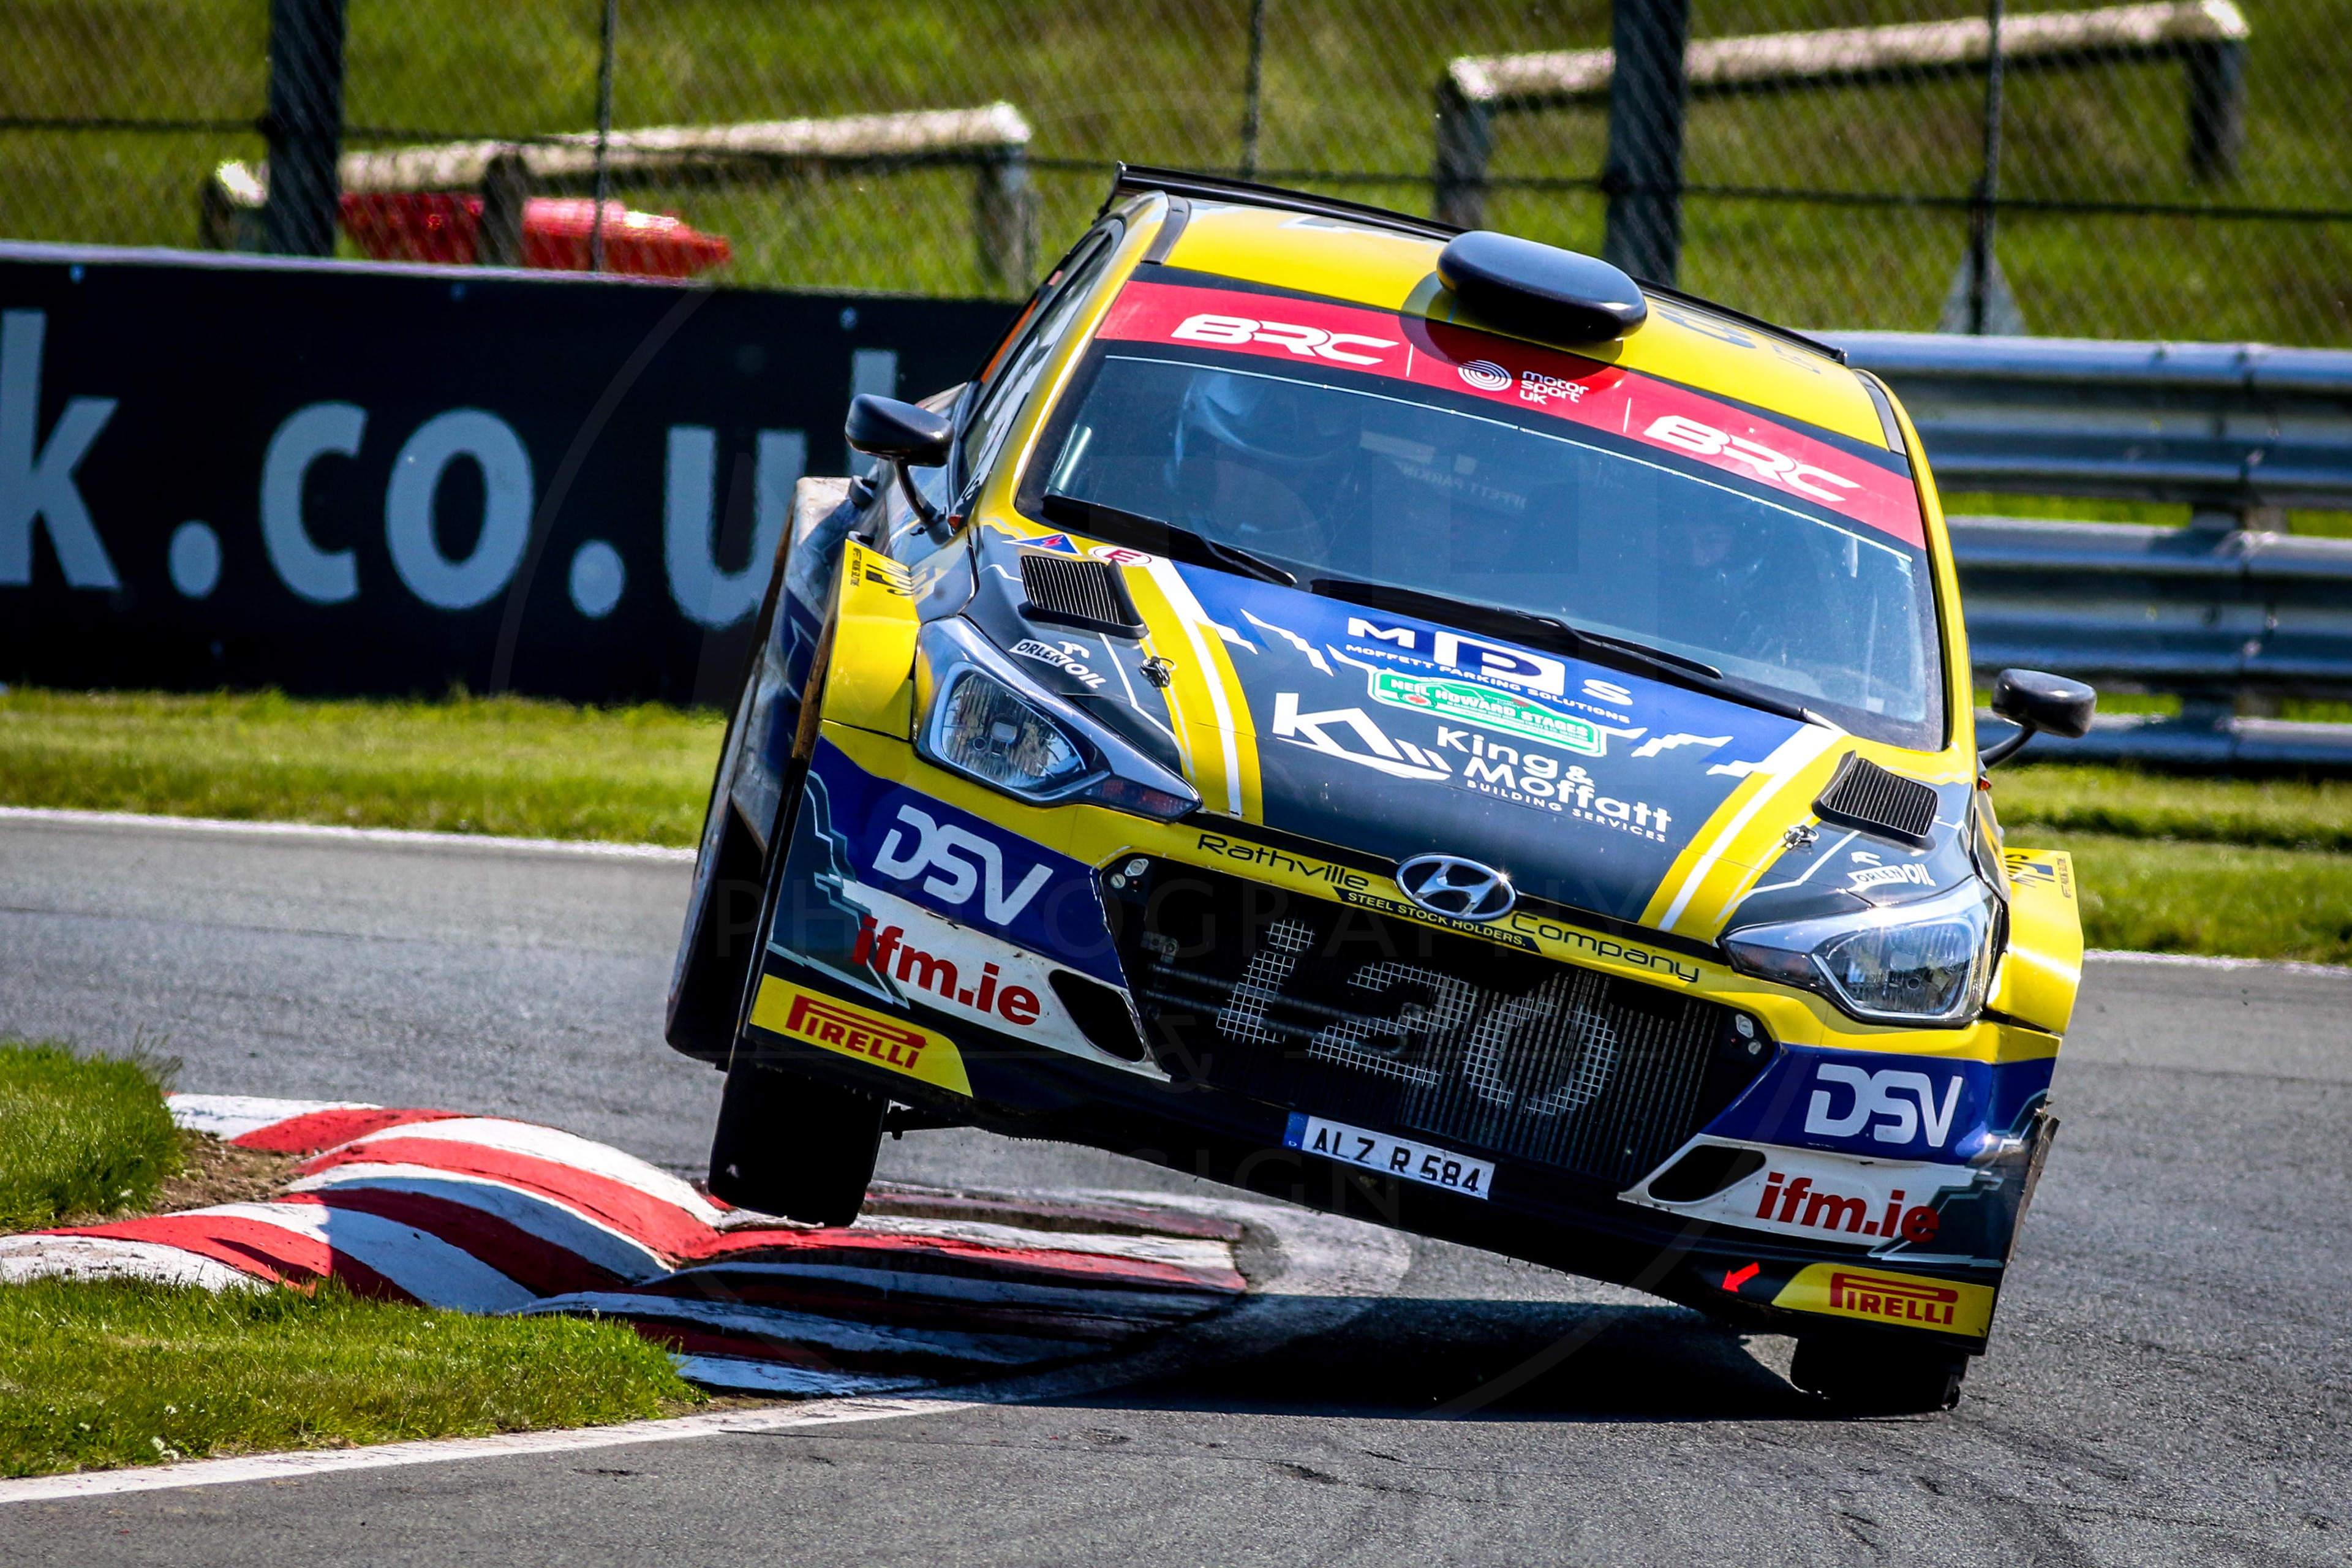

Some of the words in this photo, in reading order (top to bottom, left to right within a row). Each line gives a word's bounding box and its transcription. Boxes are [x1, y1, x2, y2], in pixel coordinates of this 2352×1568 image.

[1170, 313, 1400, 366] BRC
[1520, 380, 1580, 403] sport
[1522, 371, 1589, 395] motor
[1643, 415, 1862, 502] BRC
[1016, 642, 1067, 664] ORLEN
[1064, 663, 1107, 689] OIL
[1345, 644, 1435, 669] MOFFETT
[1439, 665, 1522, 692] PARKING
[1527, 687, 1630, 725] SOLUTIONS
[1390, 677, 1431, 698] NEIL
[1434, 688, 1517, 718] HOWARD
[1520, 709, 1589, 736] STAGES
[1463, 757, 1672, 834] Moffatt
[1466, 780, 1562, 812] BUILDING
[1571, 808, 1667, 843] SERVICES
[872, 803, 1054, 926] DSV
[1197, 833, 1370, 891] Rathville
[1856, 867, 1902, 883] ORLEN
[1902, 863, 1937, 887] OIL
[1348, 892, 1393, 911] STEEL
[1398, 905, 1447, 925] STOCK
[851, 914, 1041, 1026] ifm.ie
[1511, 911, 1700, 984] Company
[785, 993, 928, 1069] PIRELLI
[1804, 1063, 1963, 1148] DSV
[1389, 1146, 1411, 1174] R
[1420, 1154, 1481, 1193] 584
[1755, 1171, 1940, 1243] ifm.ie
[1830, 1271, 1959, 1326] PIRELLI
